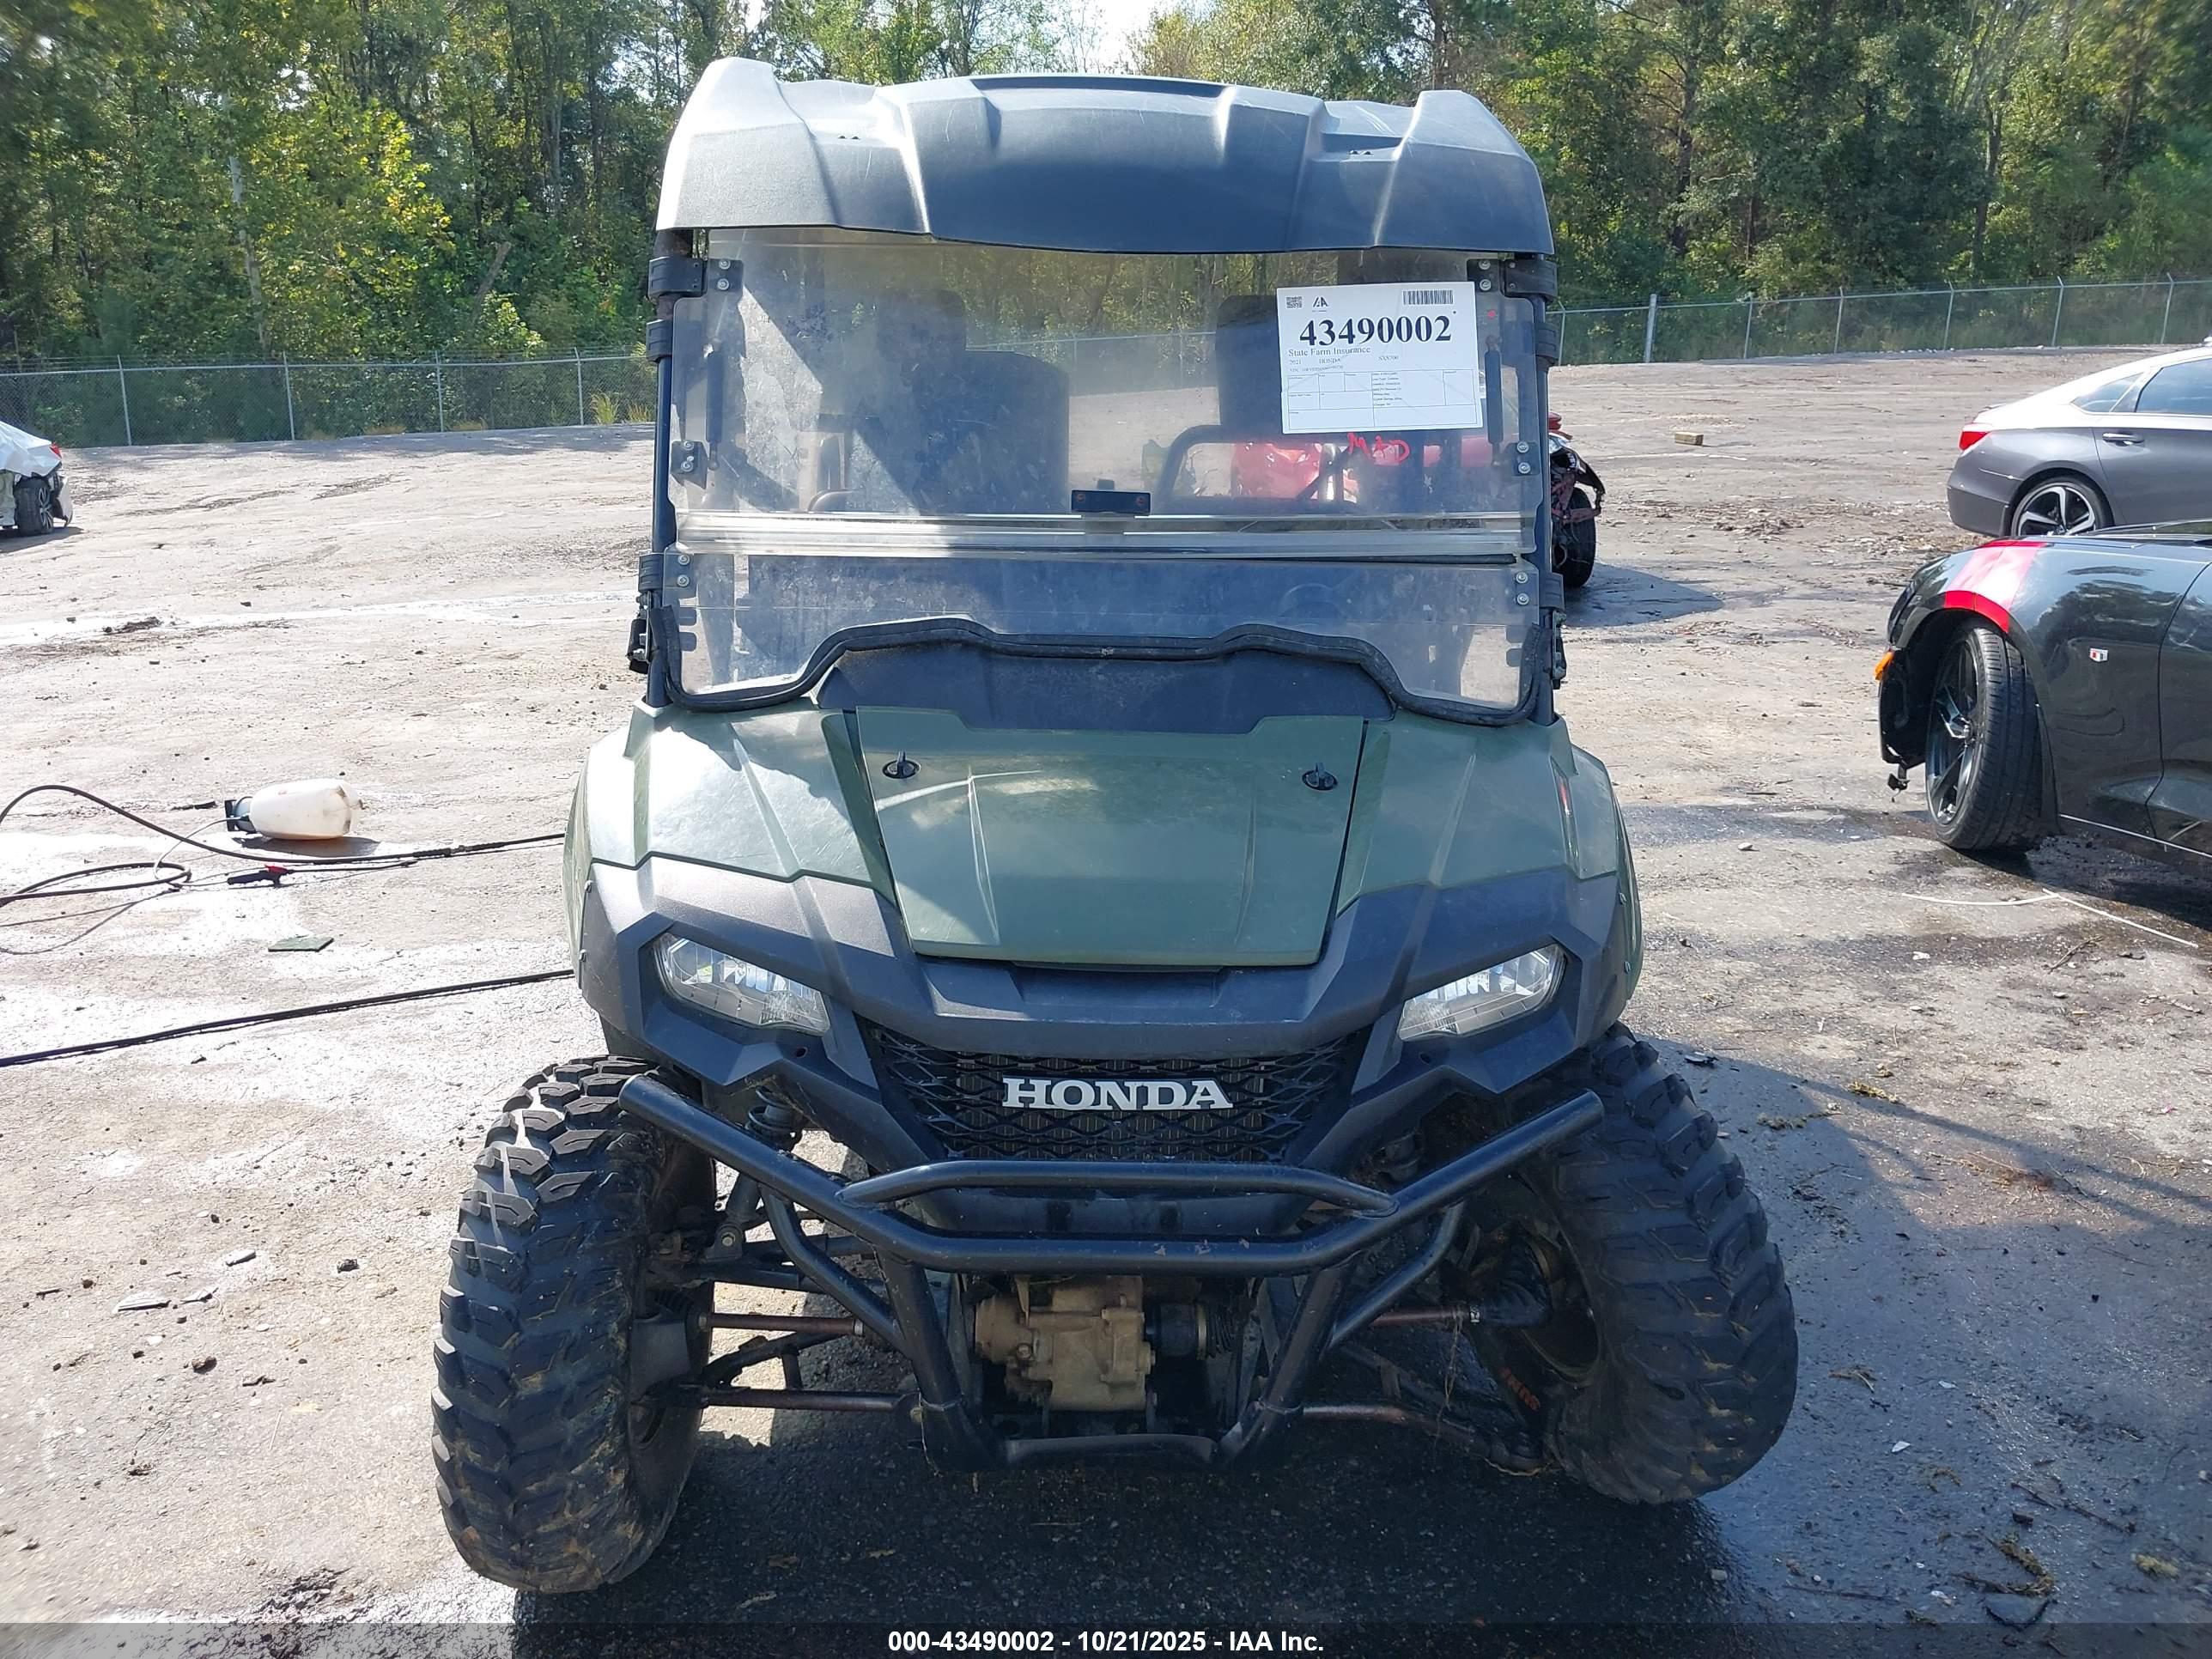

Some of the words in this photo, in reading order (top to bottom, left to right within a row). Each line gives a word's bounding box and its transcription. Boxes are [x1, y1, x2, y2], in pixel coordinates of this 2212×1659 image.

[1299, 315, 1451, 346] 43490002
[1288, 349, 1309, 357] State
[1310, 348, 1331, 356] Farm
[1001, 1077, 1234, 1111] HONDA
